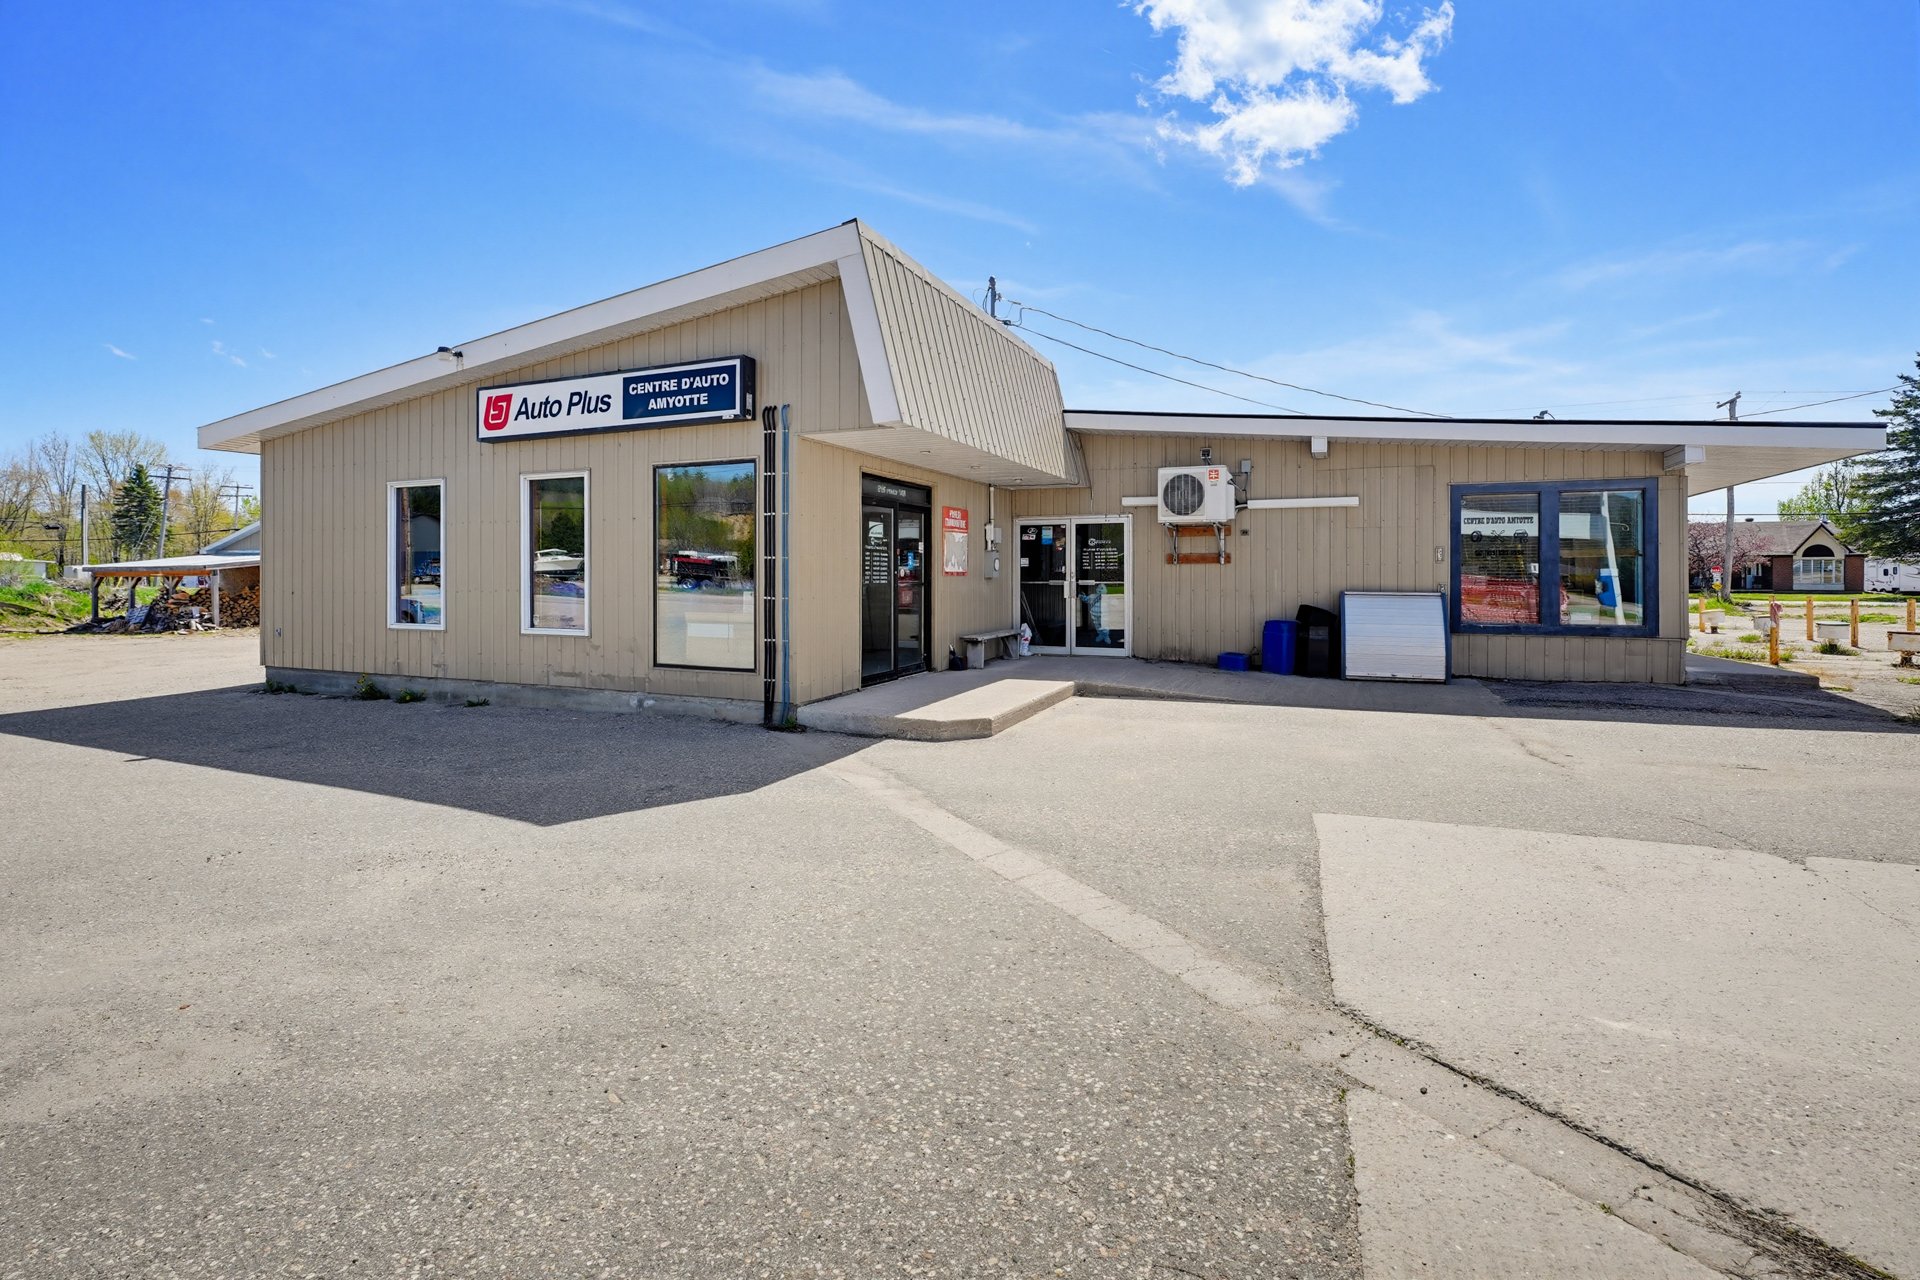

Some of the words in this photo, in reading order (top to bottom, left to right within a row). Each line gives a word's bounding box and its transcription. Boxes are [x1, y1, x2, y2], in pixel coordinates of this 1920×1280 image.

[629, 377, 678, 395] CENTRE
[681, 373, 730, 389] D'AUTO
[514, 396, 563, 421] Auto
[566, 390, 612, 416] Plus
[647, 392, 709, 410] AMYOTTE
[1463, 517, 1484, 525] CENTRE
[1486, 516, 1505, 525] D'AUTO
